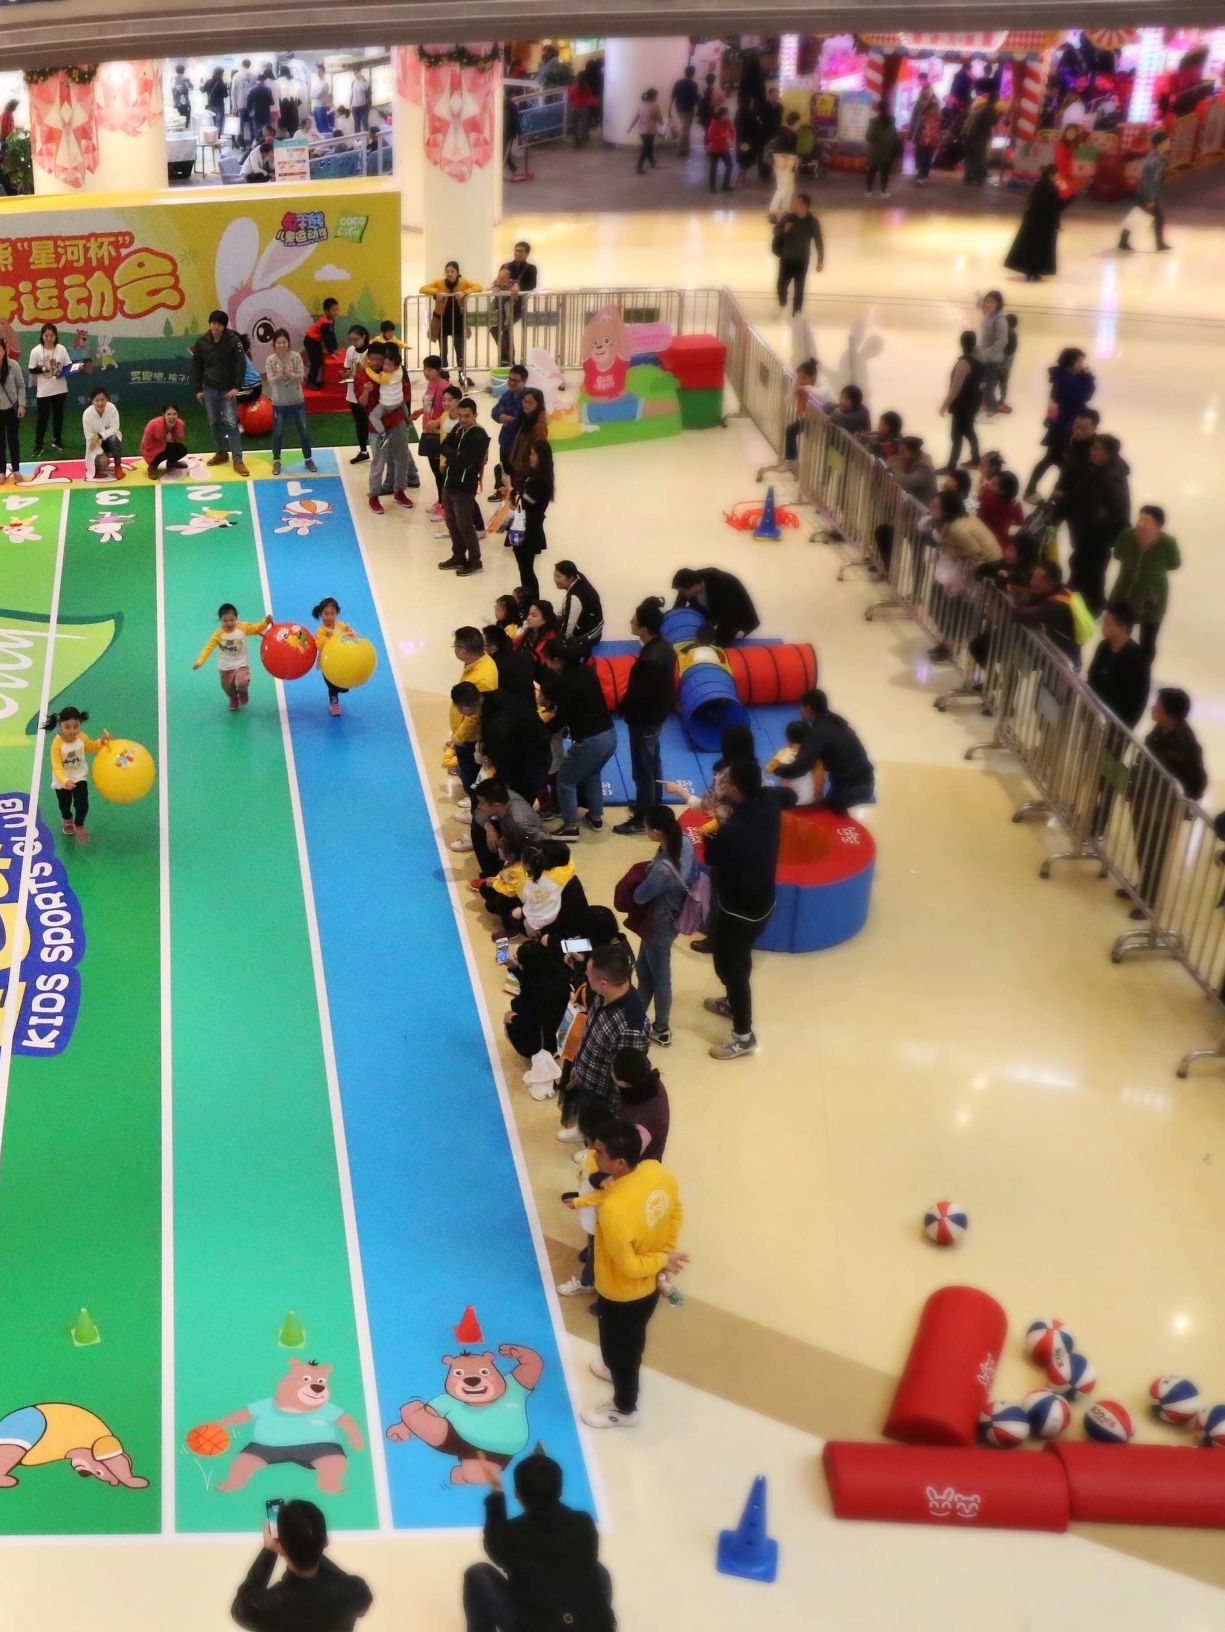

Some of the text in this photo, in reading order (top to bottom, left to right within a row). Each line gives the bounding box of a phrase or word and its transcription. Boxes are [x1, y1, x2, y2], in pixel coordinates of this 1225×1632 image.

[2, 495, 40, 511] 4
[95, 490, 131, 505] 3
[21, 973, 70, 1048] KIDS
